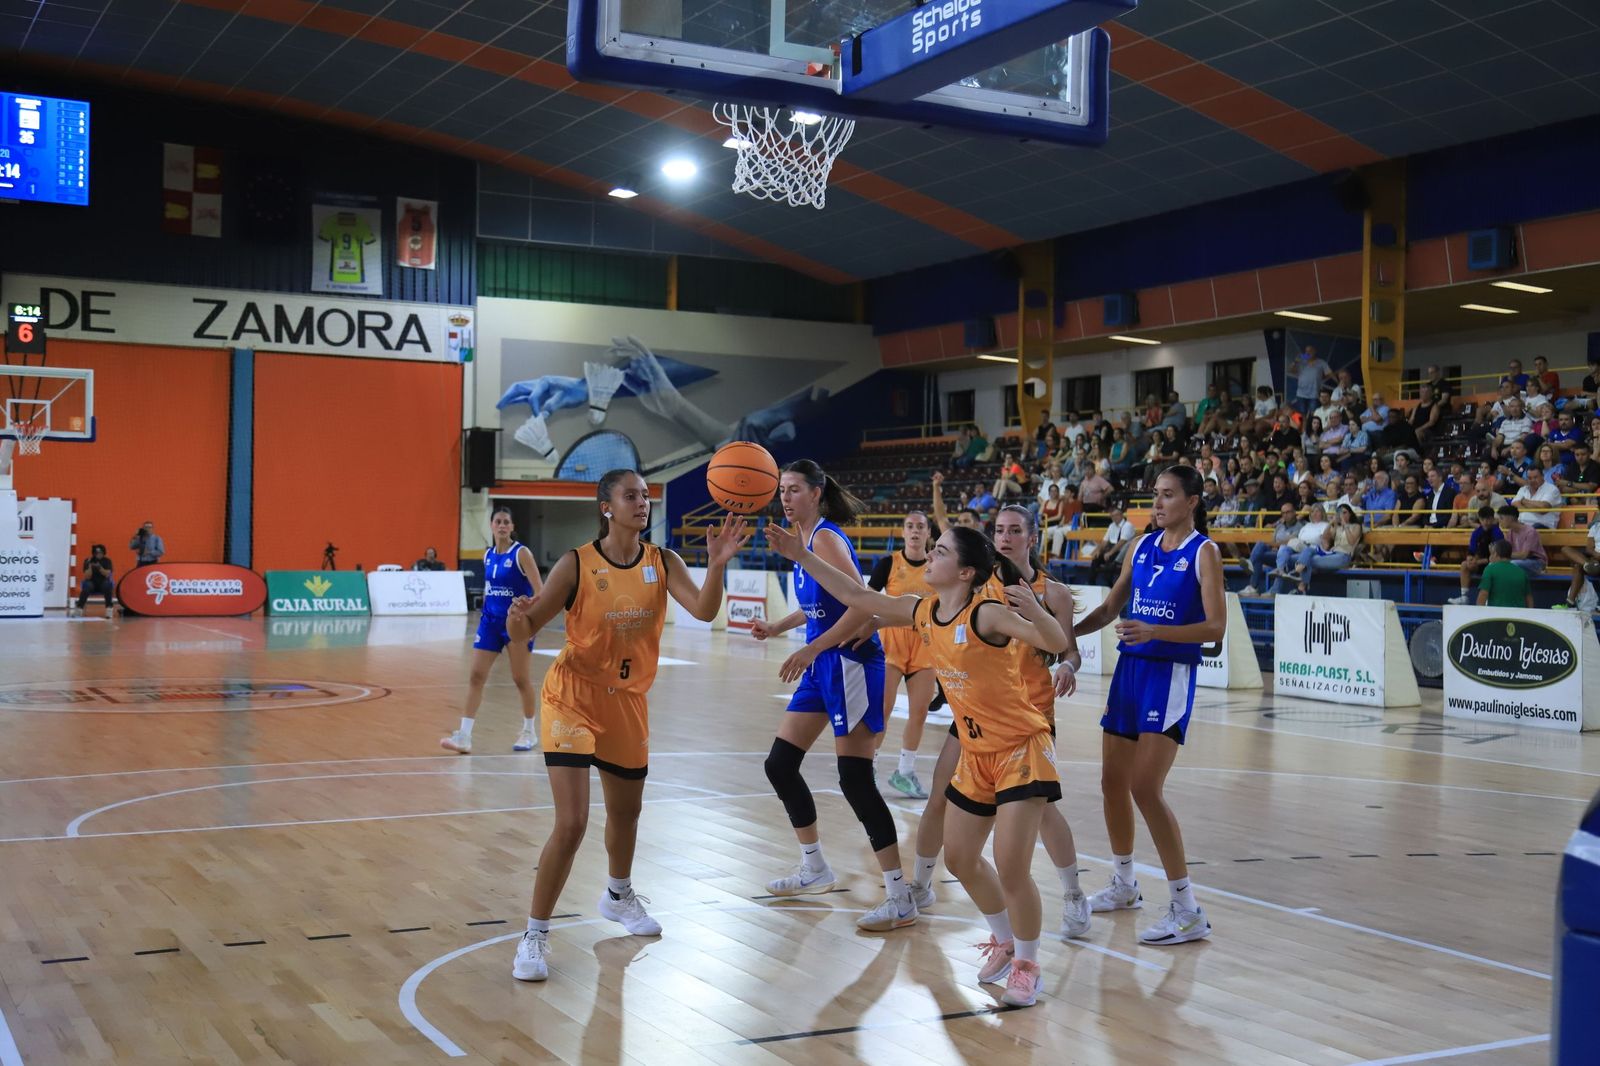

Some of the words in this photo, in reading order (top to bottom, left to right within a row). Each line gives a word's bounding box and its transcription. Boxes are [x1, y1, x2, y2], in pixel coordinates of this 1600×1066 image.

[912, 9, 981, 53] Sports
[0, 163, 20, 178] :14
[15, 305, 41, 316] 6:14
[40, 287, 116, 333] DE
[193, 298, 432, 353] ZAMORA
[18, 323, 34, 343] 6
[492, 564, 498, 579] 1
[1147, 565, 1164, 587] 7
[220, 586, 241, 594] LEÓN
[273, 599, 308, 612] CAJA
[313, 598, 368, 612] RURAL
[1459, 632, 1512, 663] Paulino
[1519, 637, 1570, 670] Iglesias
[619, 658, 632, 680] 5
[1198, 660, 1224, 669] RUCKS
[1280, 661, 1351, 684] HERBI-PLAST,
[1356, 670, 1376, 684] S.L.
[1477, 667, 1509, 678] Embutidos
[1510, 671, 1515, 679] y
[1515, 671, 1543, 681] Jamones
[1280, 678, 1376, 697] SEÑALIZACIONES
[1448, 697, 1577, 722] www.paulinoiglesias.com
